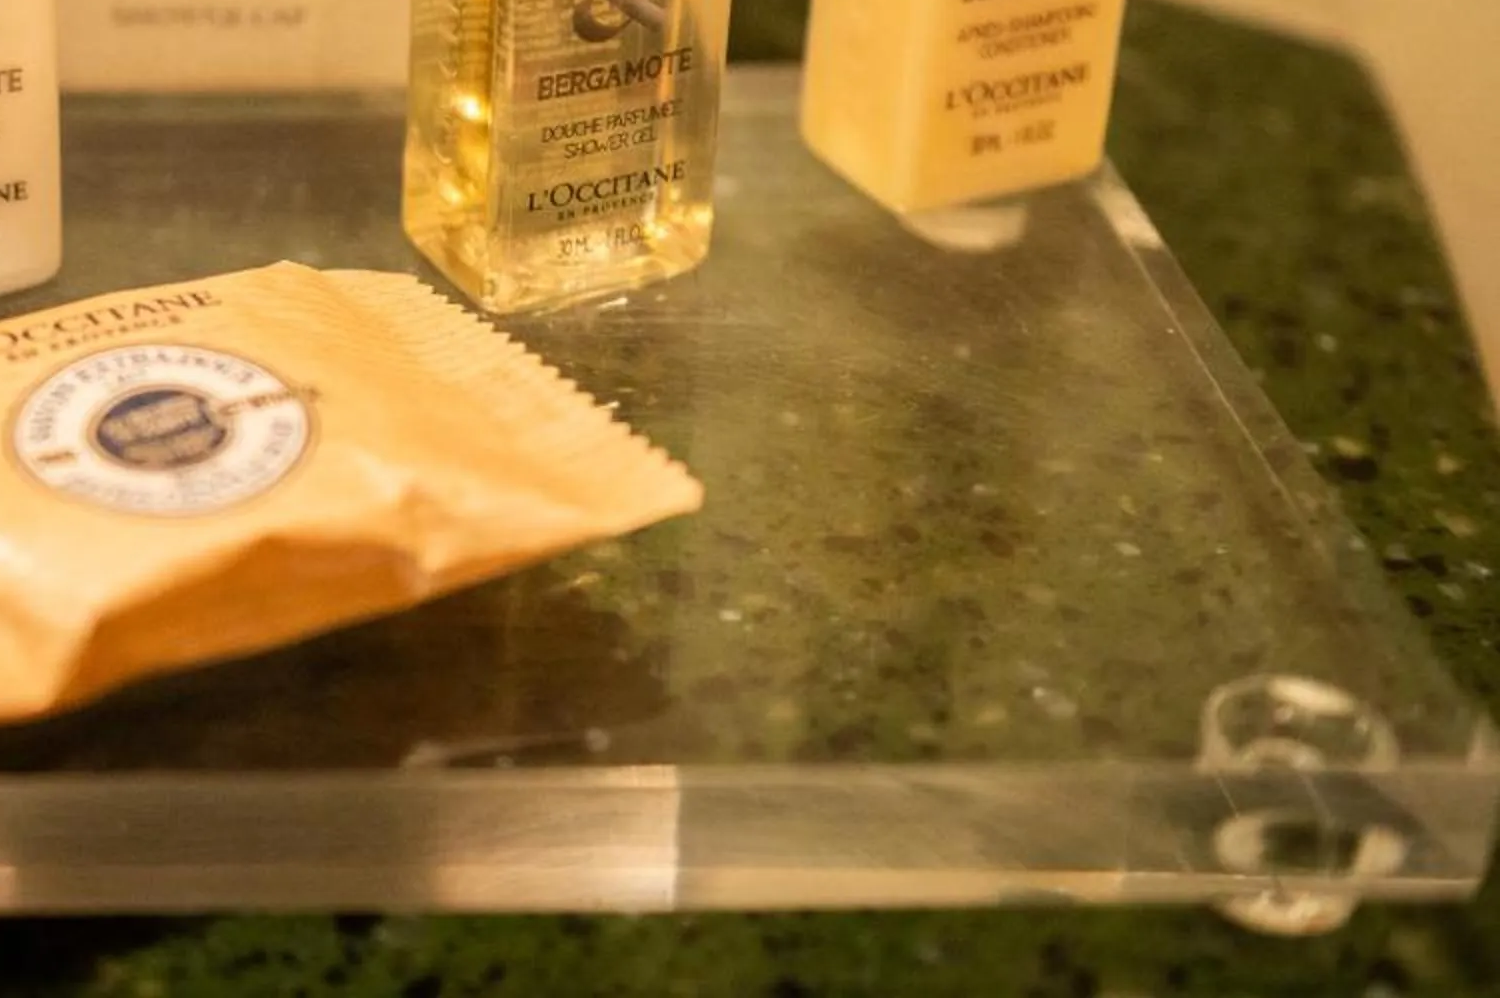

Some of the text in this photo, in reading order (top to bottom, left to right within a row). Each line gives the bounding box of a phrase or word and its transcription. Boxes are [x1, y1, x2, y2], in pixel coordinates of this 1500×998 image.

[538, 48, 693, 101] BERGAMOTE
[542, 117, 602, 143] DOUCHE
[565, 126, 657, 159] SHOWER GEL
[528, 159, 686, 211] L'OCCITANE
